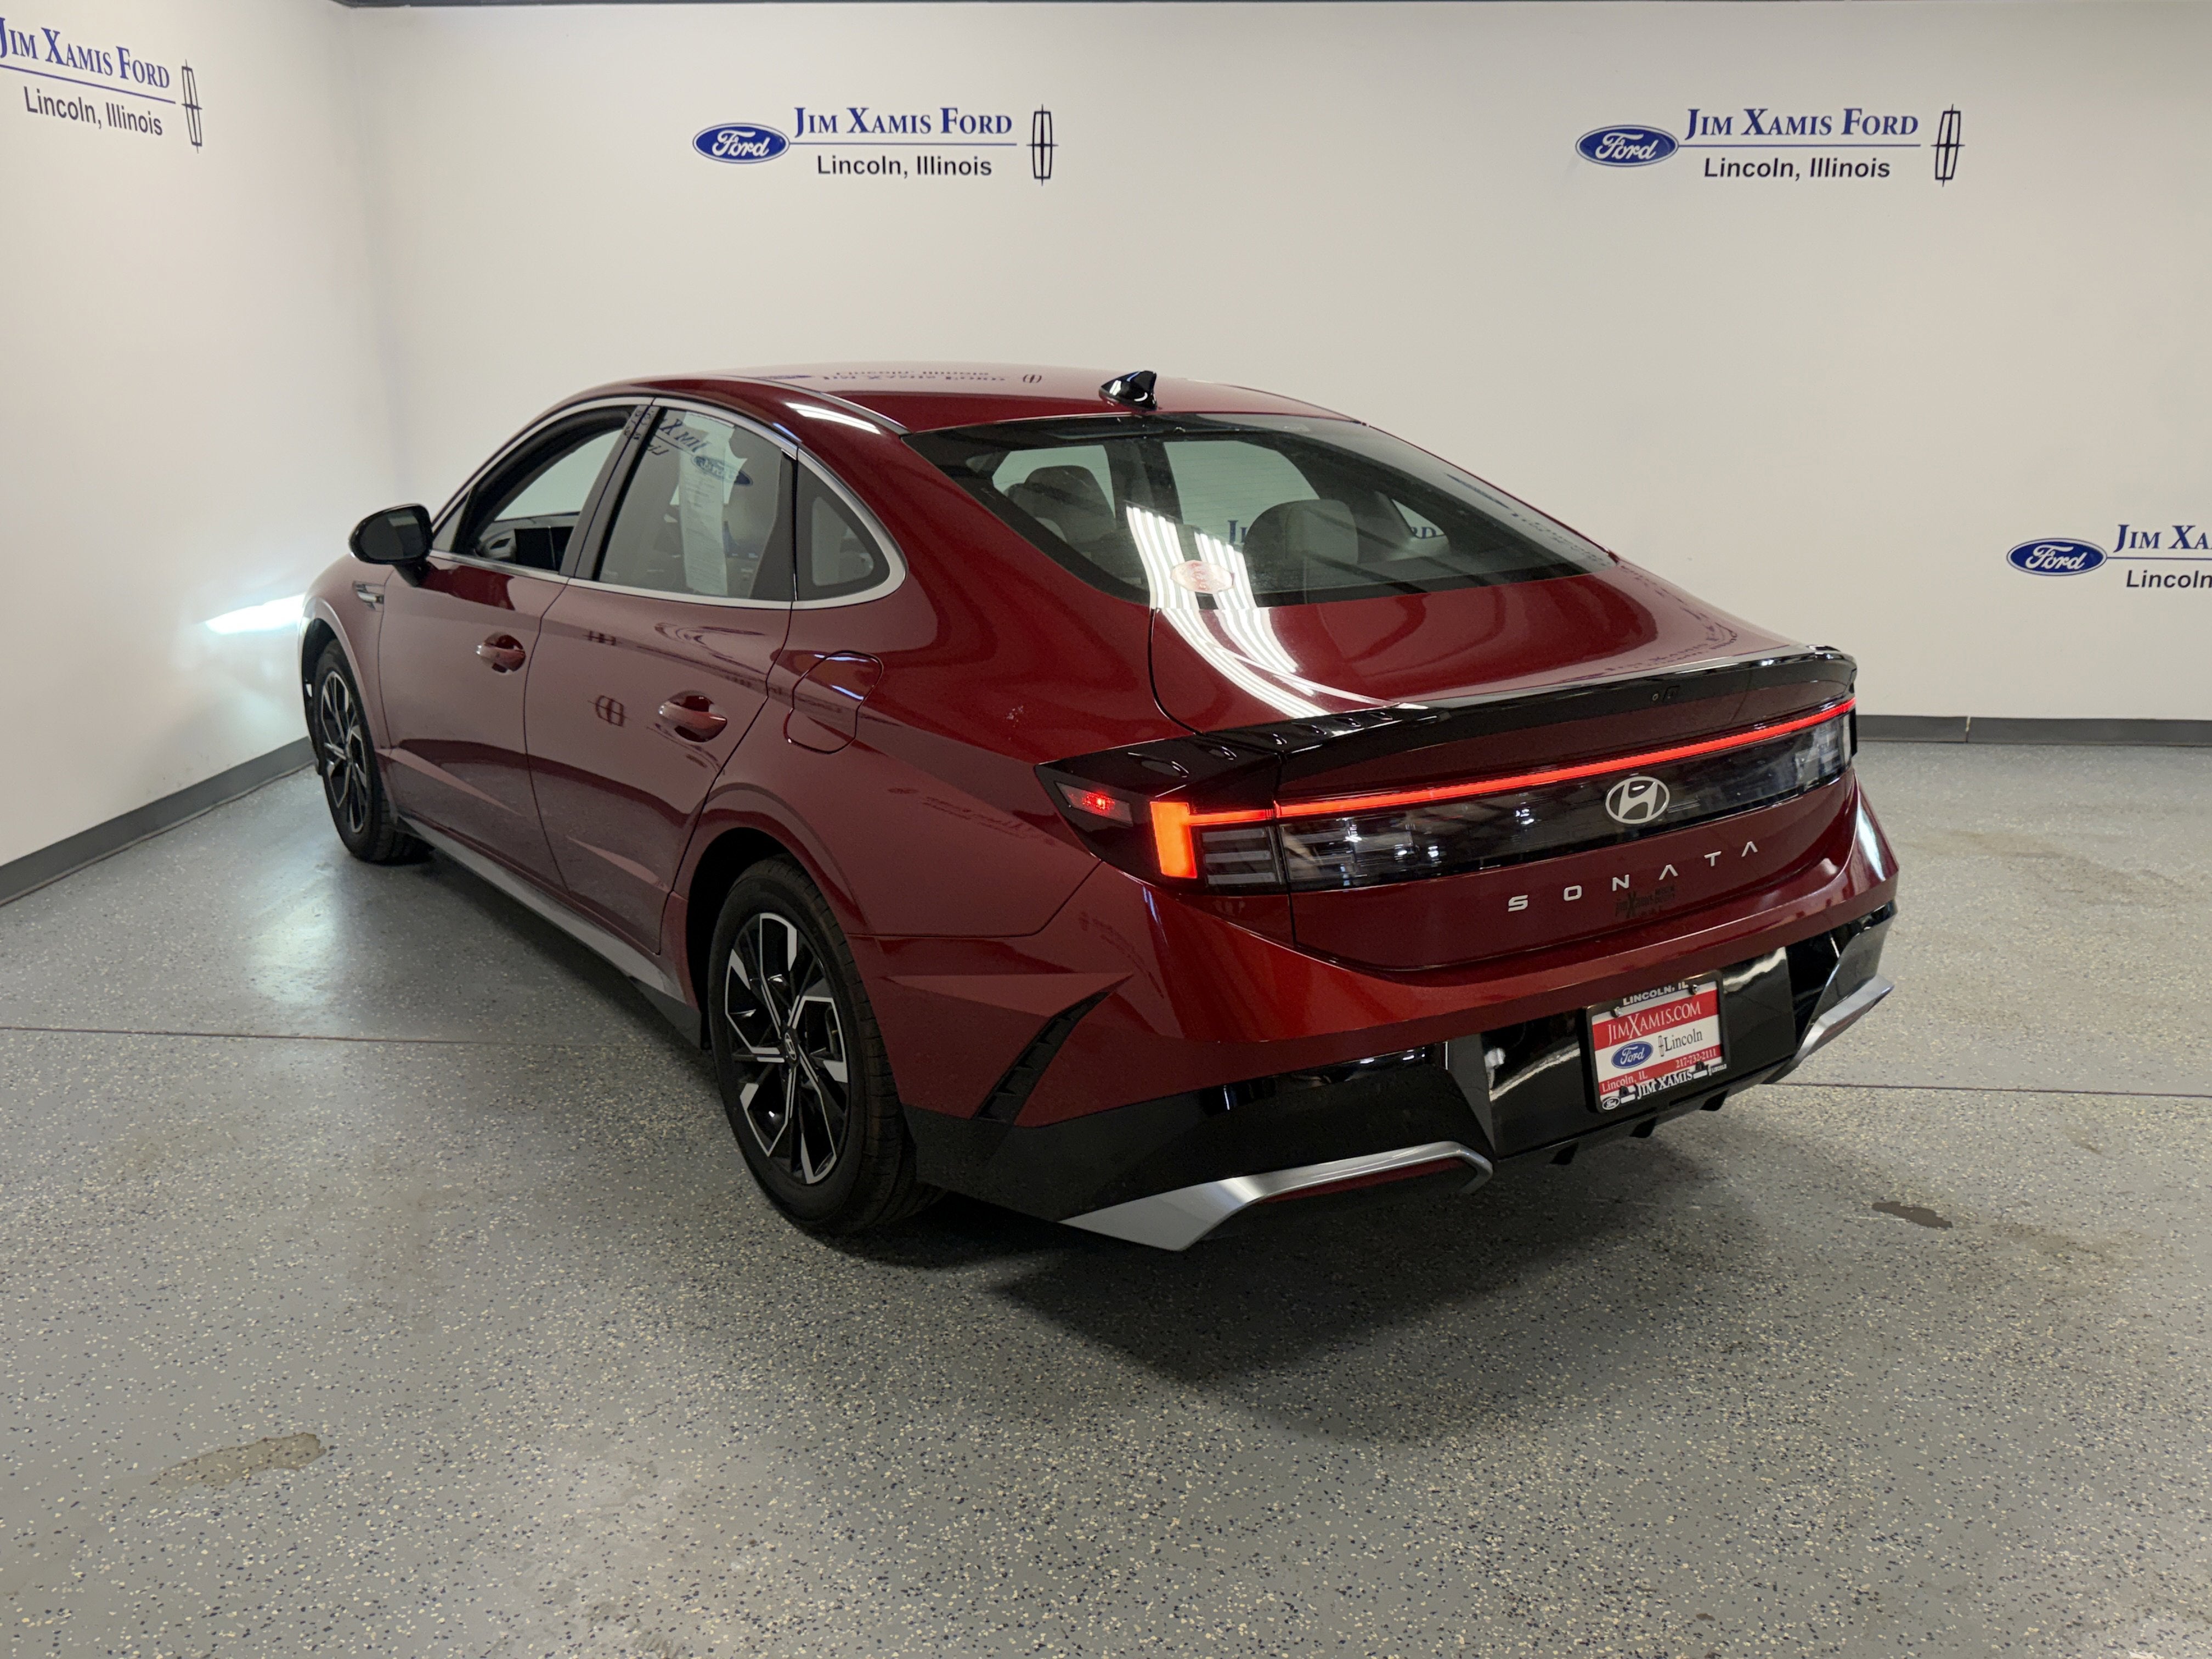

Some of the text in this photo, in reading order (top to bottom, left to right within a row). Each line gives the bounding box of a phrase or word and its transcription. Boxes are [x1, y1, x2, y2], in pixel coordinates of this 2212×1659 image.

[0, 16, 170, 88] JIM XAMIS FORD
[24, 86, 162, 136] Lincoln, Illinois
[794, 108, 1012, 138] JIM XAMIS FORD
[1684, 109, 1918, 140] JIM XAMIS FORD
[712, 129, 770, 157] Ford
[1595, 132, 1656, 160] Ford
[817, 156, 992, 179] Lincoln, Illinois
[1704, 157, 1890, 182] Lincoln, Illinois
[2113, 524, 2212, 553] JIM XA
[2025, 544, 2087, 569] Ford
[2126, 570, 2212, 588] Lincoln
[1508, 841, 1758, 912] SONATA
[1622, 981, 1689, 1006] LINCOLN, IL
[1607, 1001, 1702, 1046] JIMXAMIS.COM
[1663, 1028, 1703, 1052] Lincoln
[1620, 1045, 1645, 1065] Ford
[1675, 1048, 1717, 1069] 217-732-2111
[1602, 1070, 1648, 1093] Lincoln, IL
[1637, 1070, 1694, 1099] JIM XAMIS
